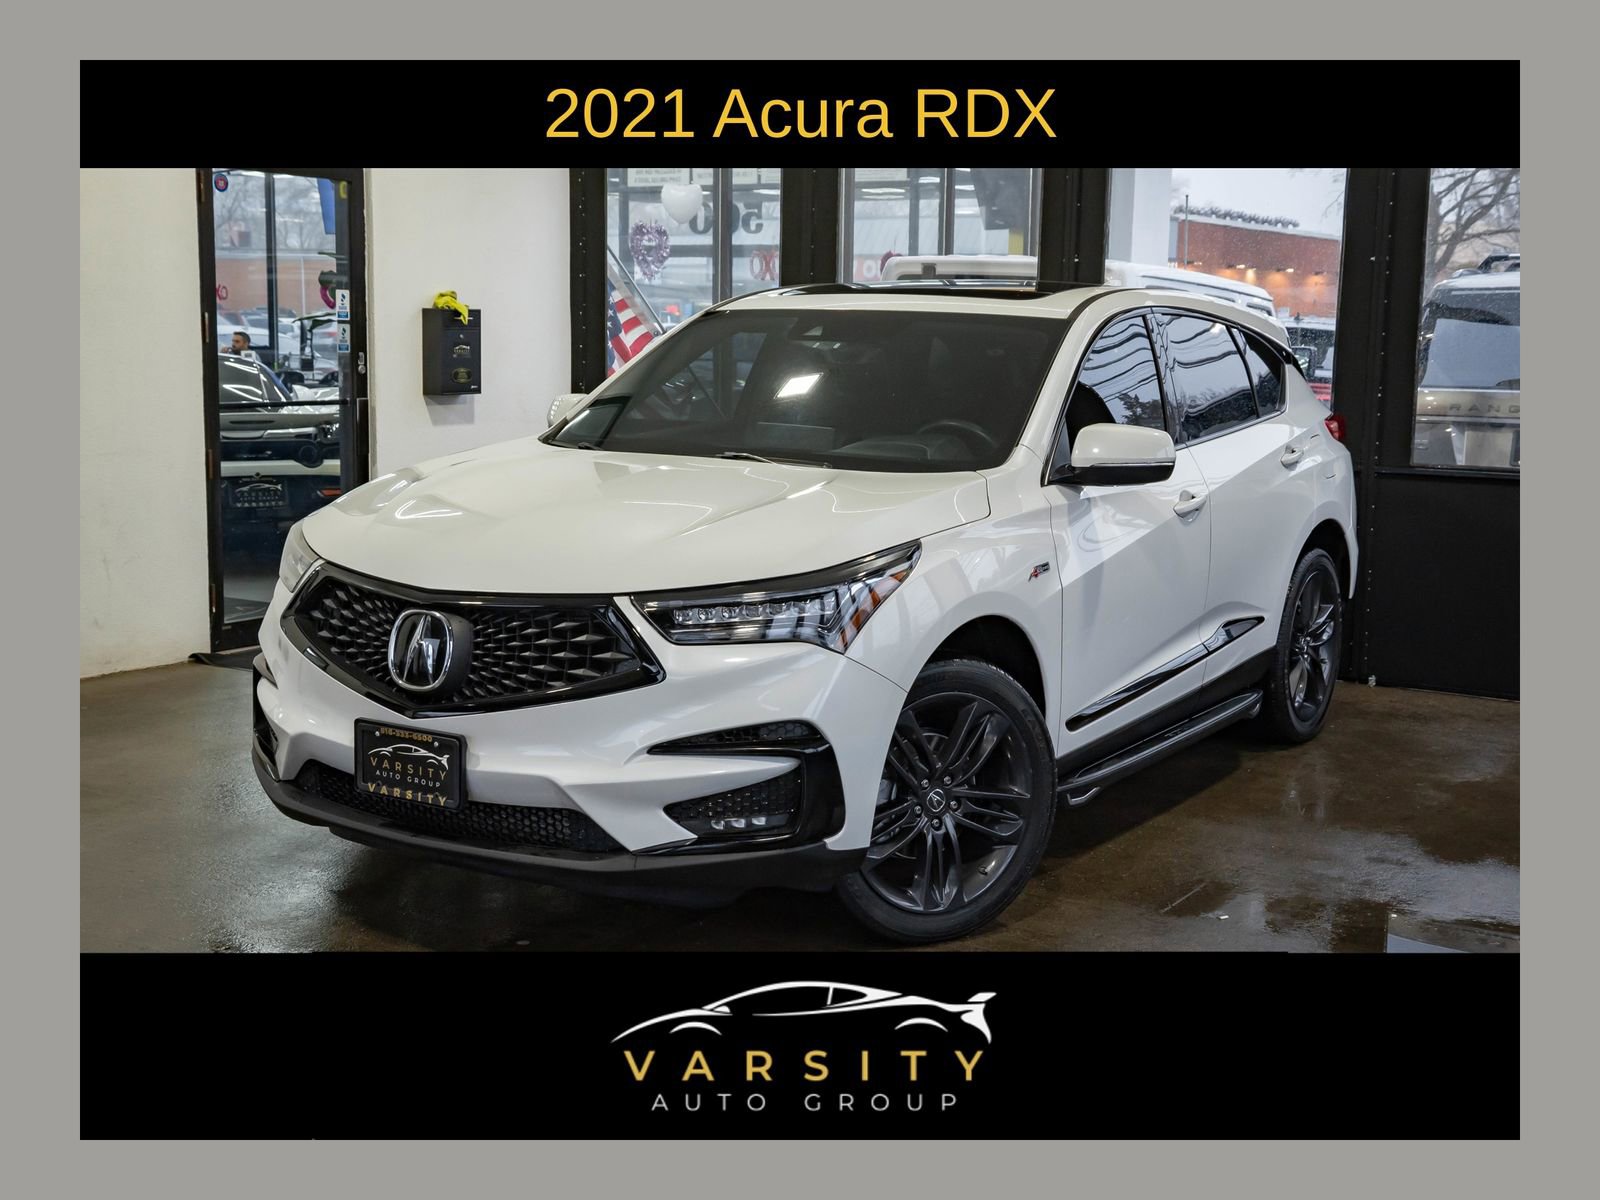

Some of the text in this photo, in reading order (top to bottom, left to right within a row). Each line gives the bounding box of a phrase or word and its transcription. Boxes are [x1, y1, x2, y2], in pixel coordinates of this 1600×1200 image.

[1449, 403, 1520, 413] RANG
[370, 757, 446, 780] VARSITY
[375, 770, 441, 788] AUTO GROUP
[368, 783, 446, 806] VARSITY
